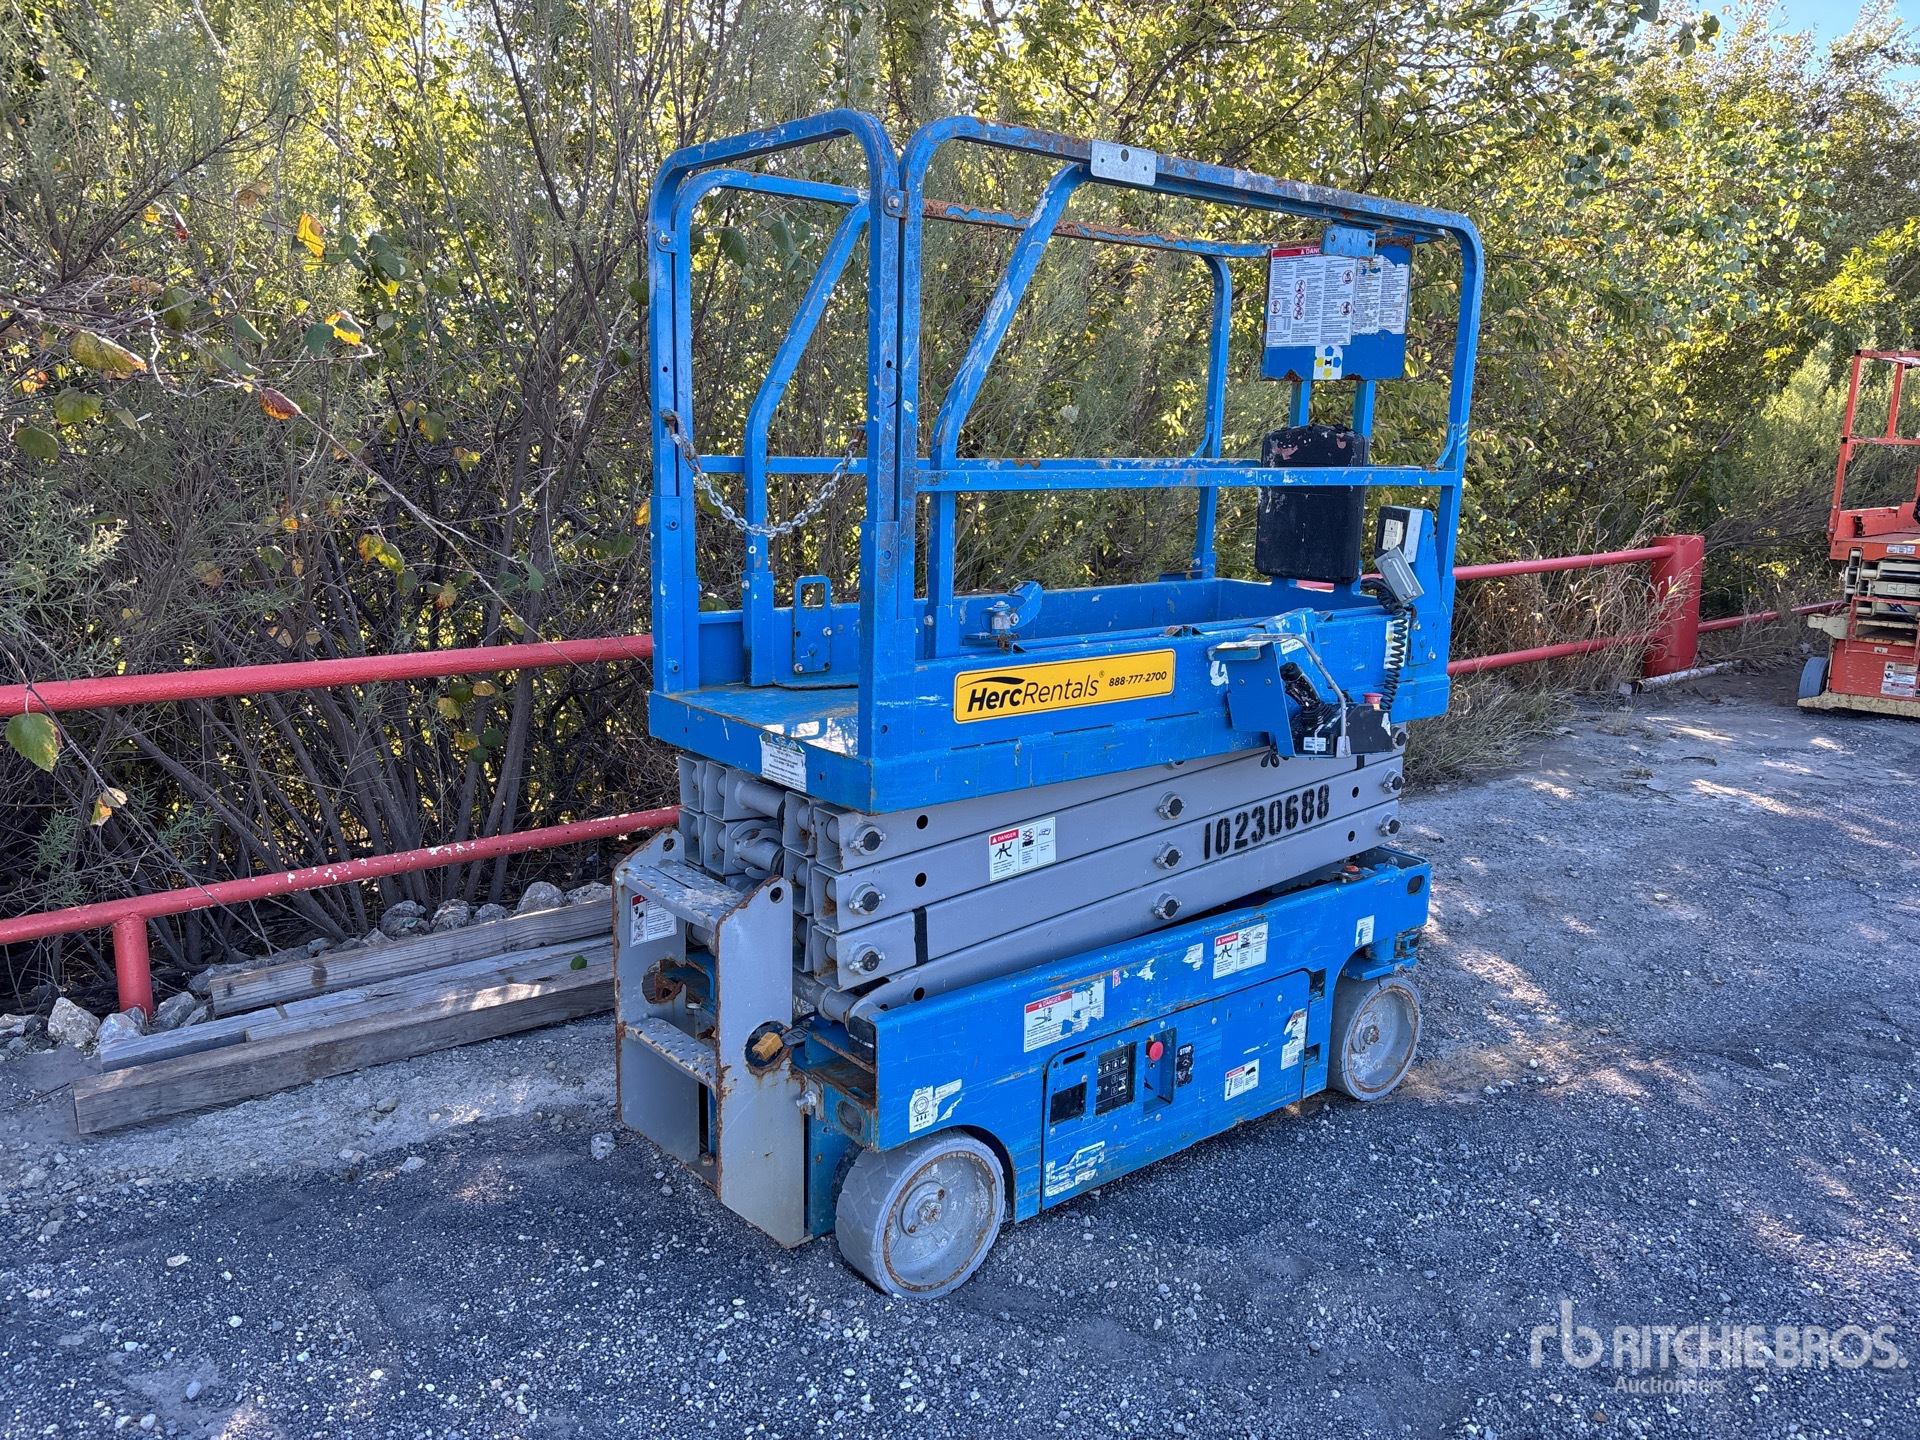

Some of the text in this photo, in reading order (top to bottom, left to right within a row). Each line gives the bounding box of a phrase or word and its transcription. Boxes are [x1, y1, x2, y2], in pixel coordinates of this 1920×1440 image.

[1109, 670, 1167, 687] 888-777-2700
[1203, 784, 1330, 860] 10230688
[997, 831, 1017, 842] DANGER
[1042, 995, 1062, 1007] DANGER
[1180, 1045, 1192, 1056] STOP
